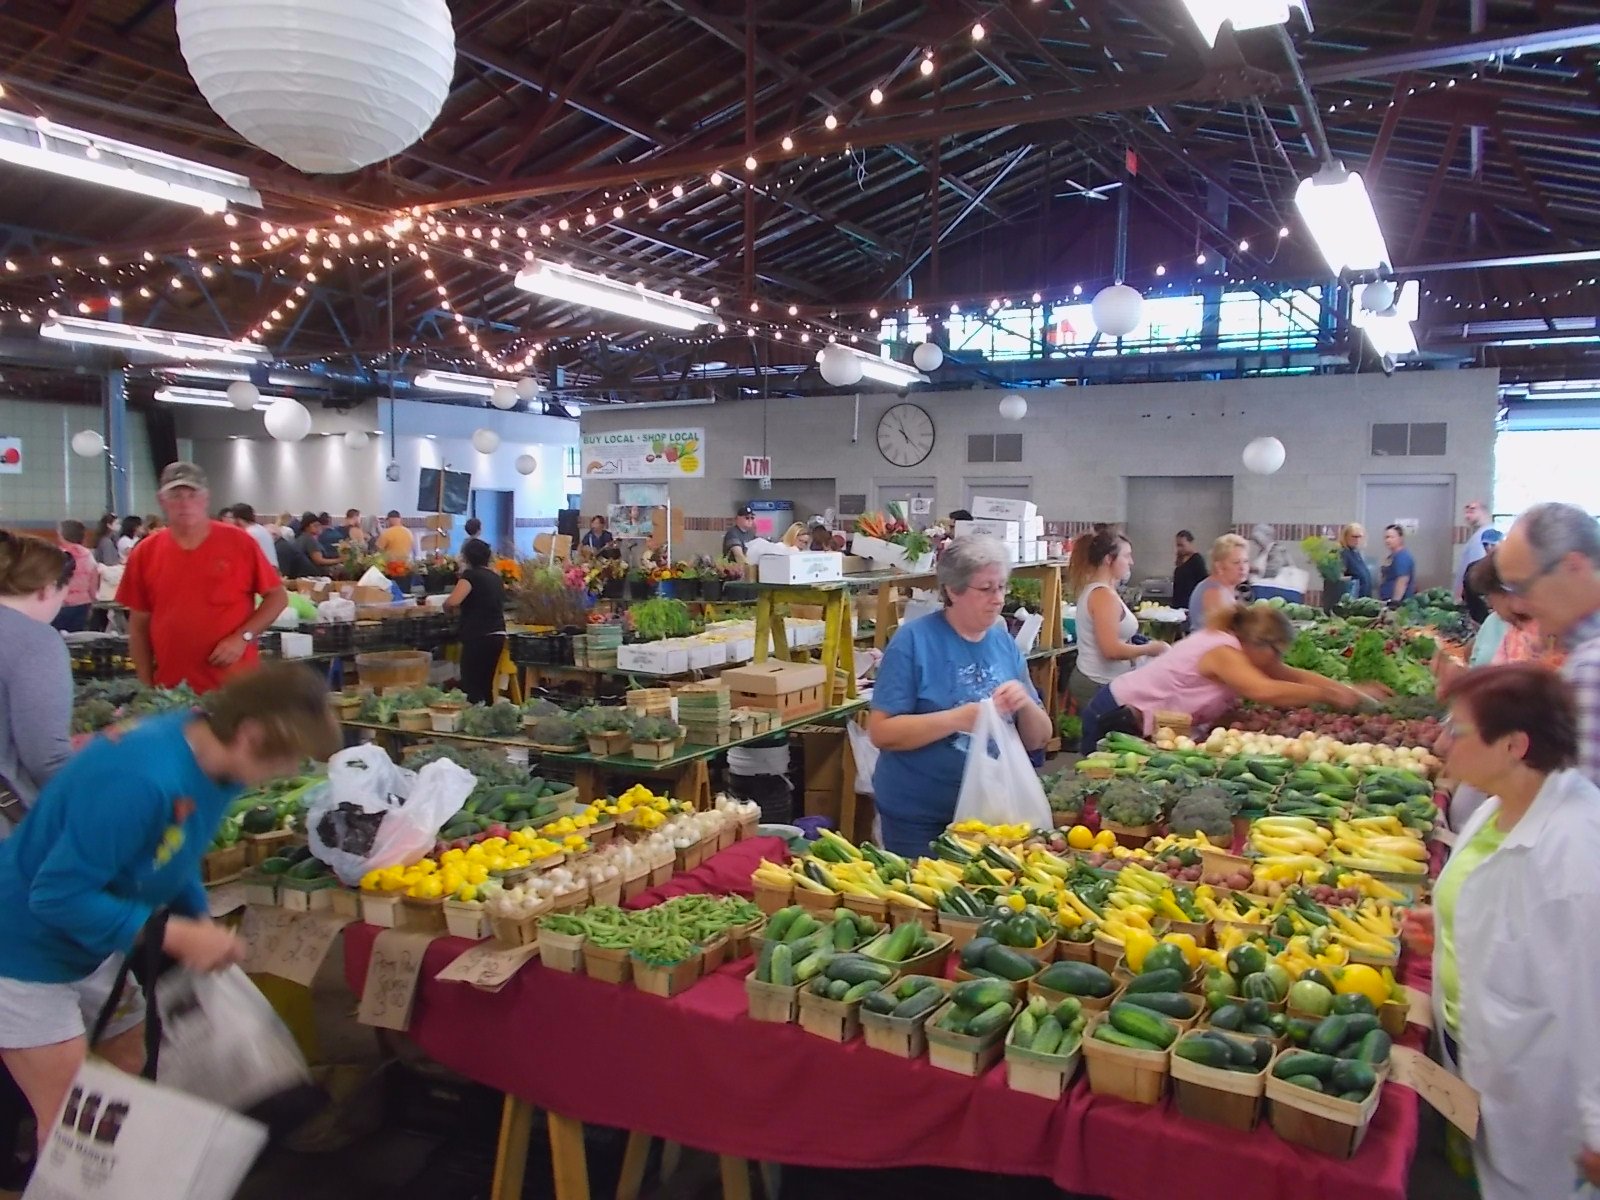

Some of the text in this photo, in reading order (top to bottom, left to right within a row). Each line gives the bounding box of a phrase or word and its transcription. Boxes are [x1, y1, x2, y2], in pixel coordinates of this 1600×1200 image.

[583, 431, 700, 445] BUY LOCAL SHOP LOCAL
[744, 458, 770, 476] ATM
